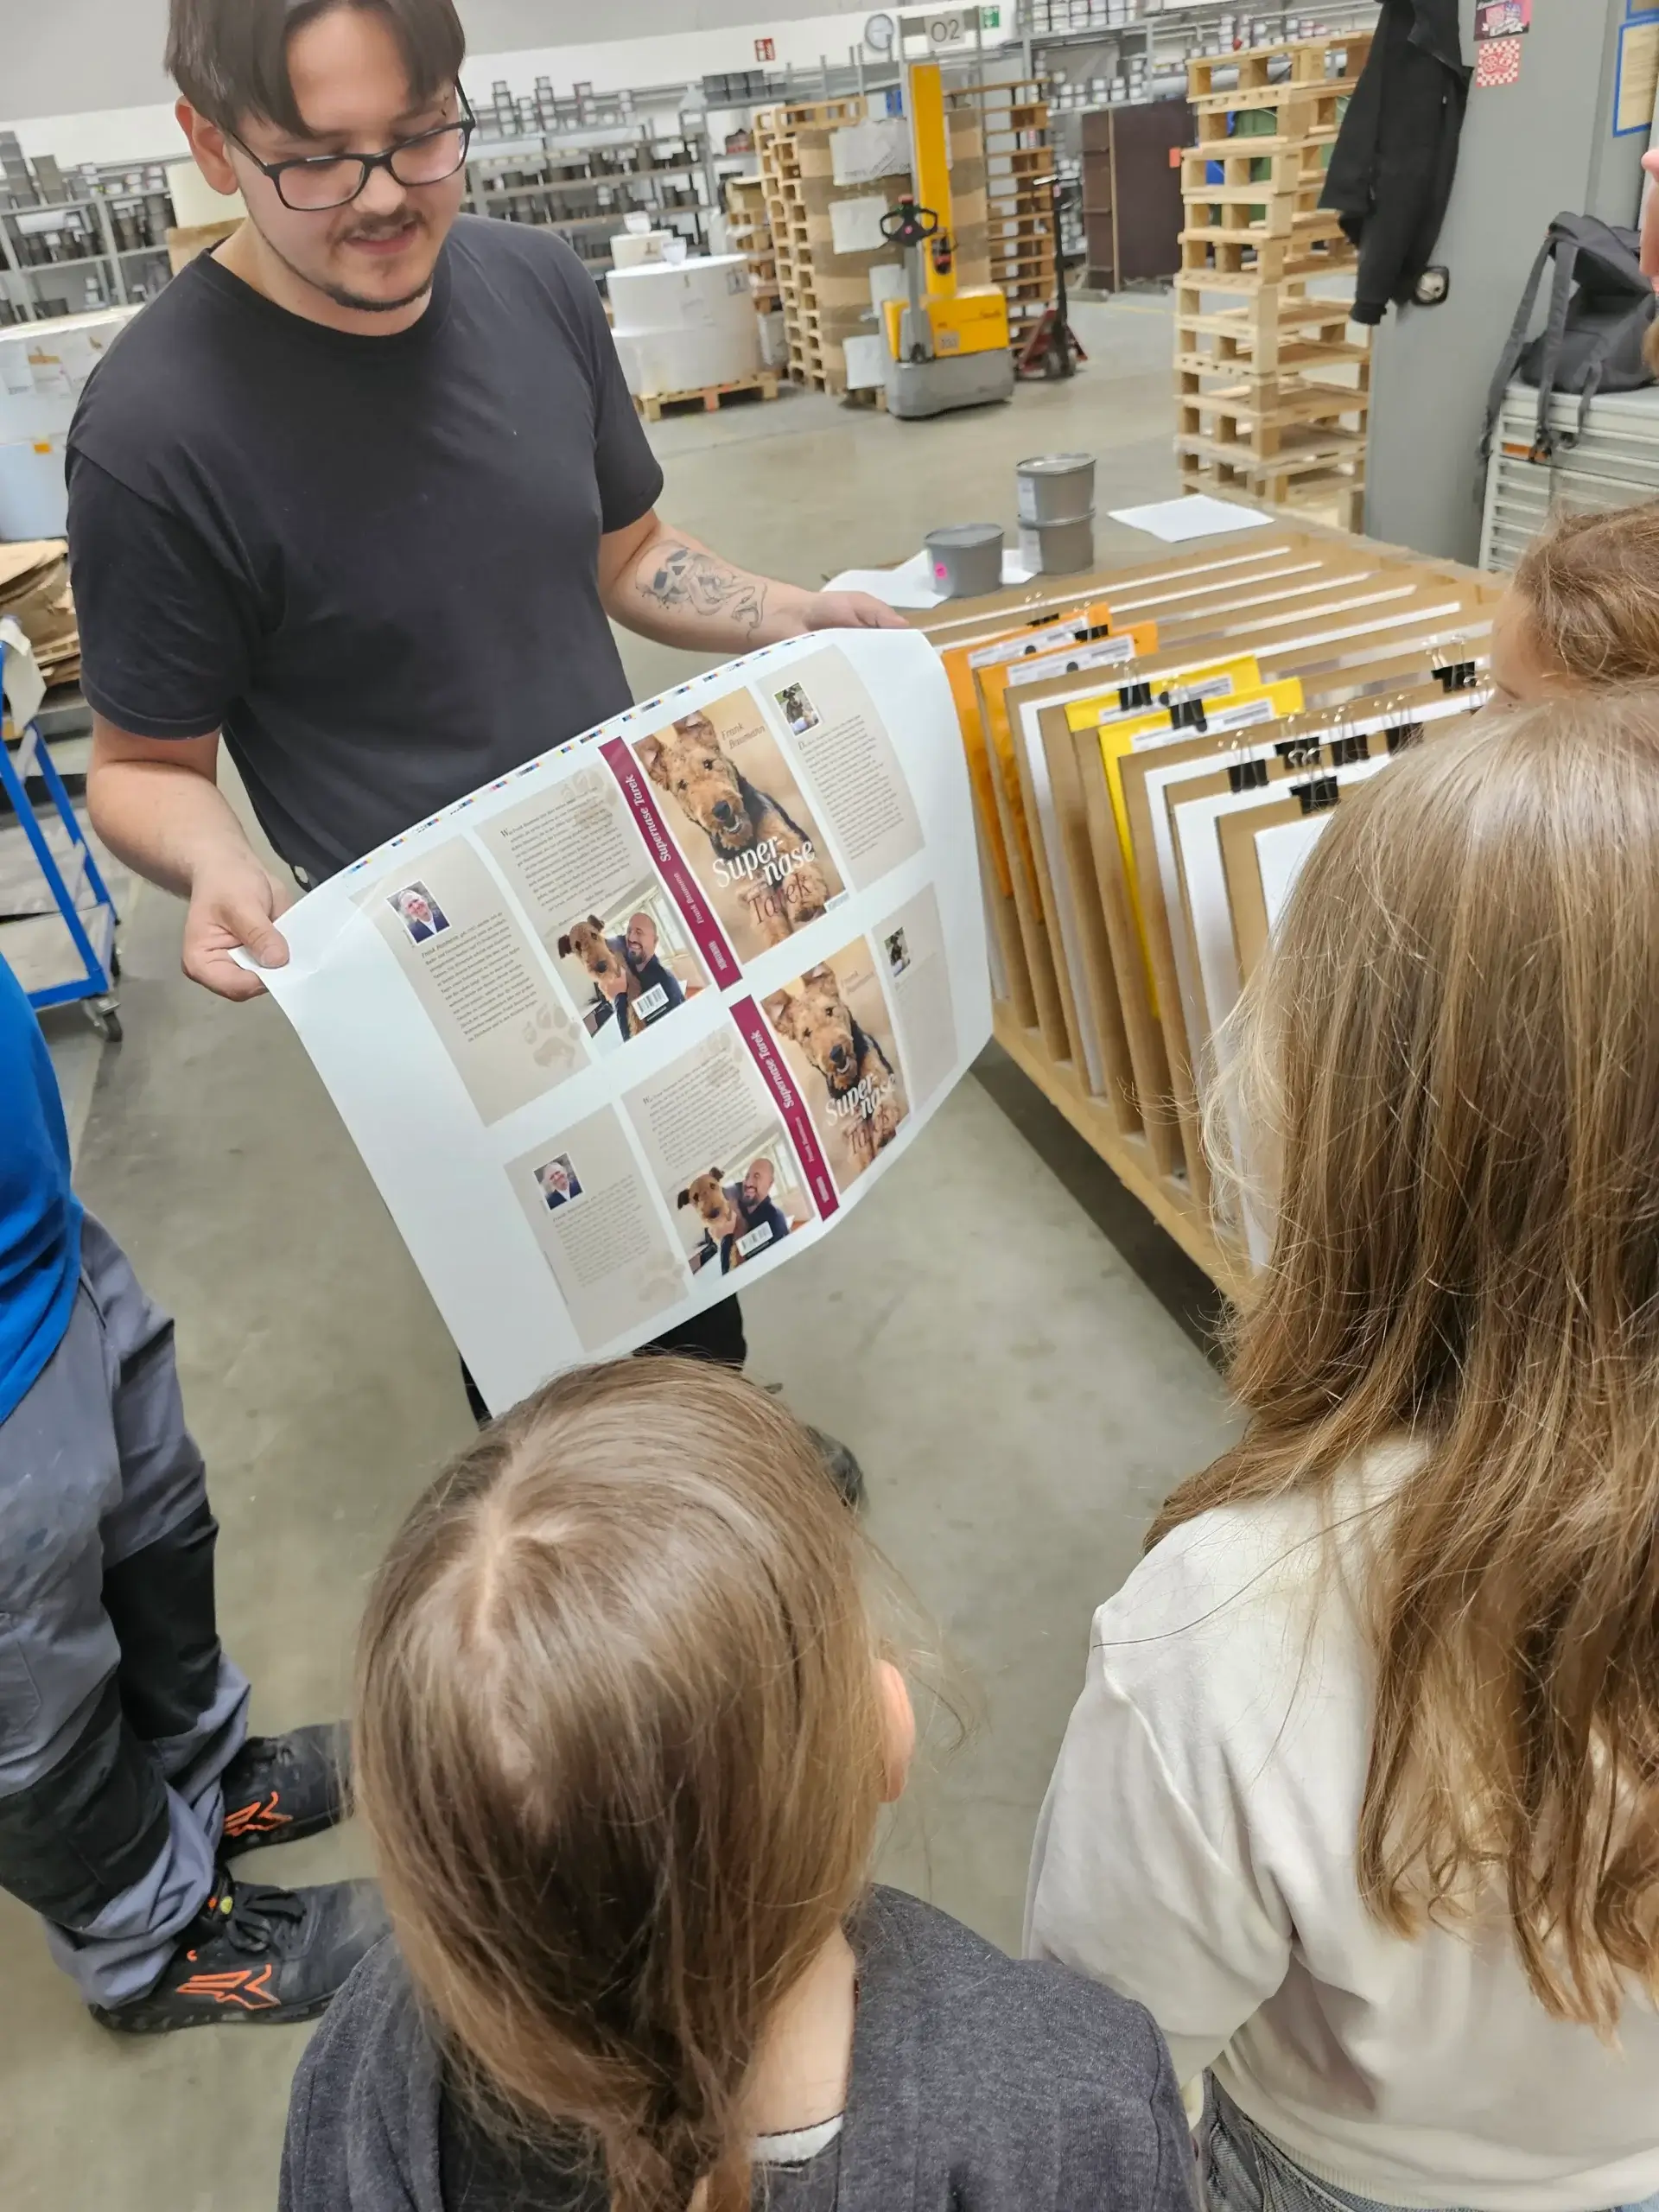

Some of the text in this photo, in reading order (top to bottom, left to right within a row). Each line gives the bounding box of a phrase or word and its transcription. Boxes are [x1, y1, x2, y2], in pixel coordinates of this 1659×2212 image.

[626, 774, 671, 862] Supernase Tarek
[712, 836, 784, 888] Super-
[762, 841, 816, 886] nase
[690, 904, 705, 925] Frank
[751, 1029, 794, 1109] Supernase Tarek
